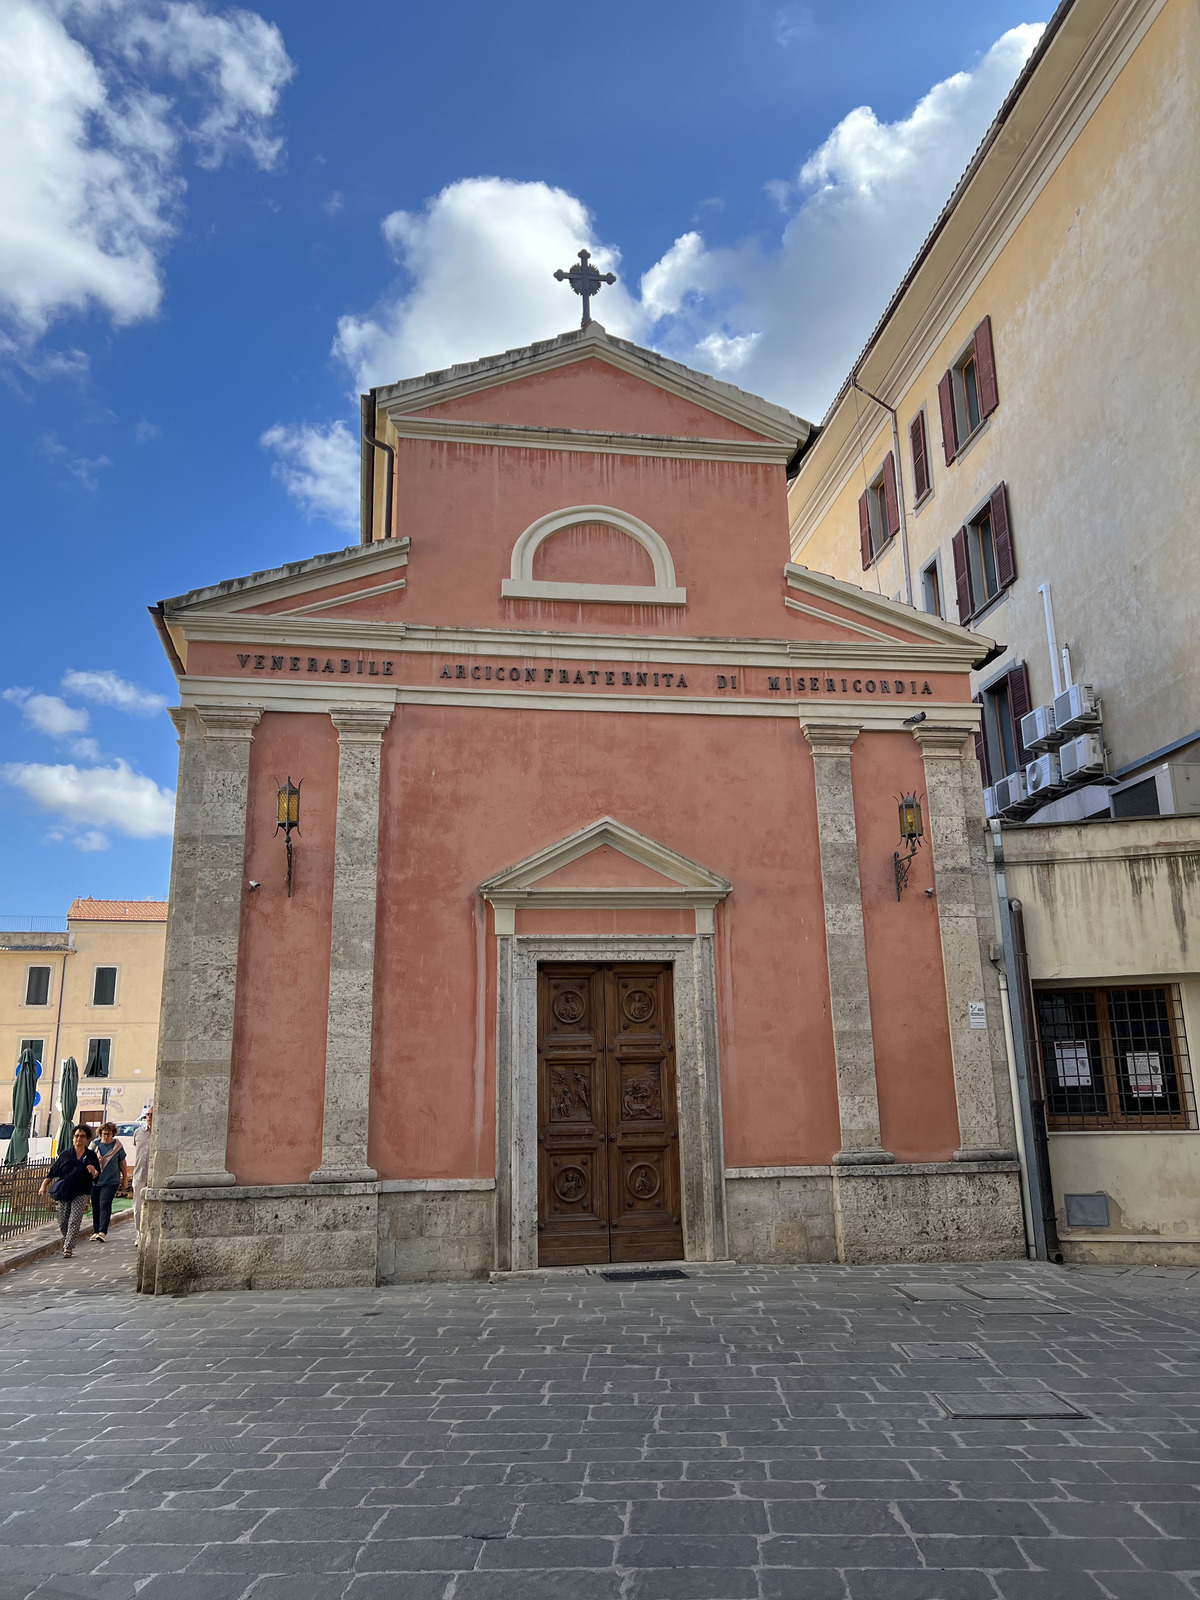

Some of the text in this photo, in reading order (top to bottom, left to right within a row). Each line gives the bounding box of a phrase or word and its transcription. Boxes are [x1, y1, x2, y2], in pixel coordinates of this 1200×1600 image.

[237, 654, 933, 694] VENERABILE ARCICONFRATERNITA DI MISERICORDIA
